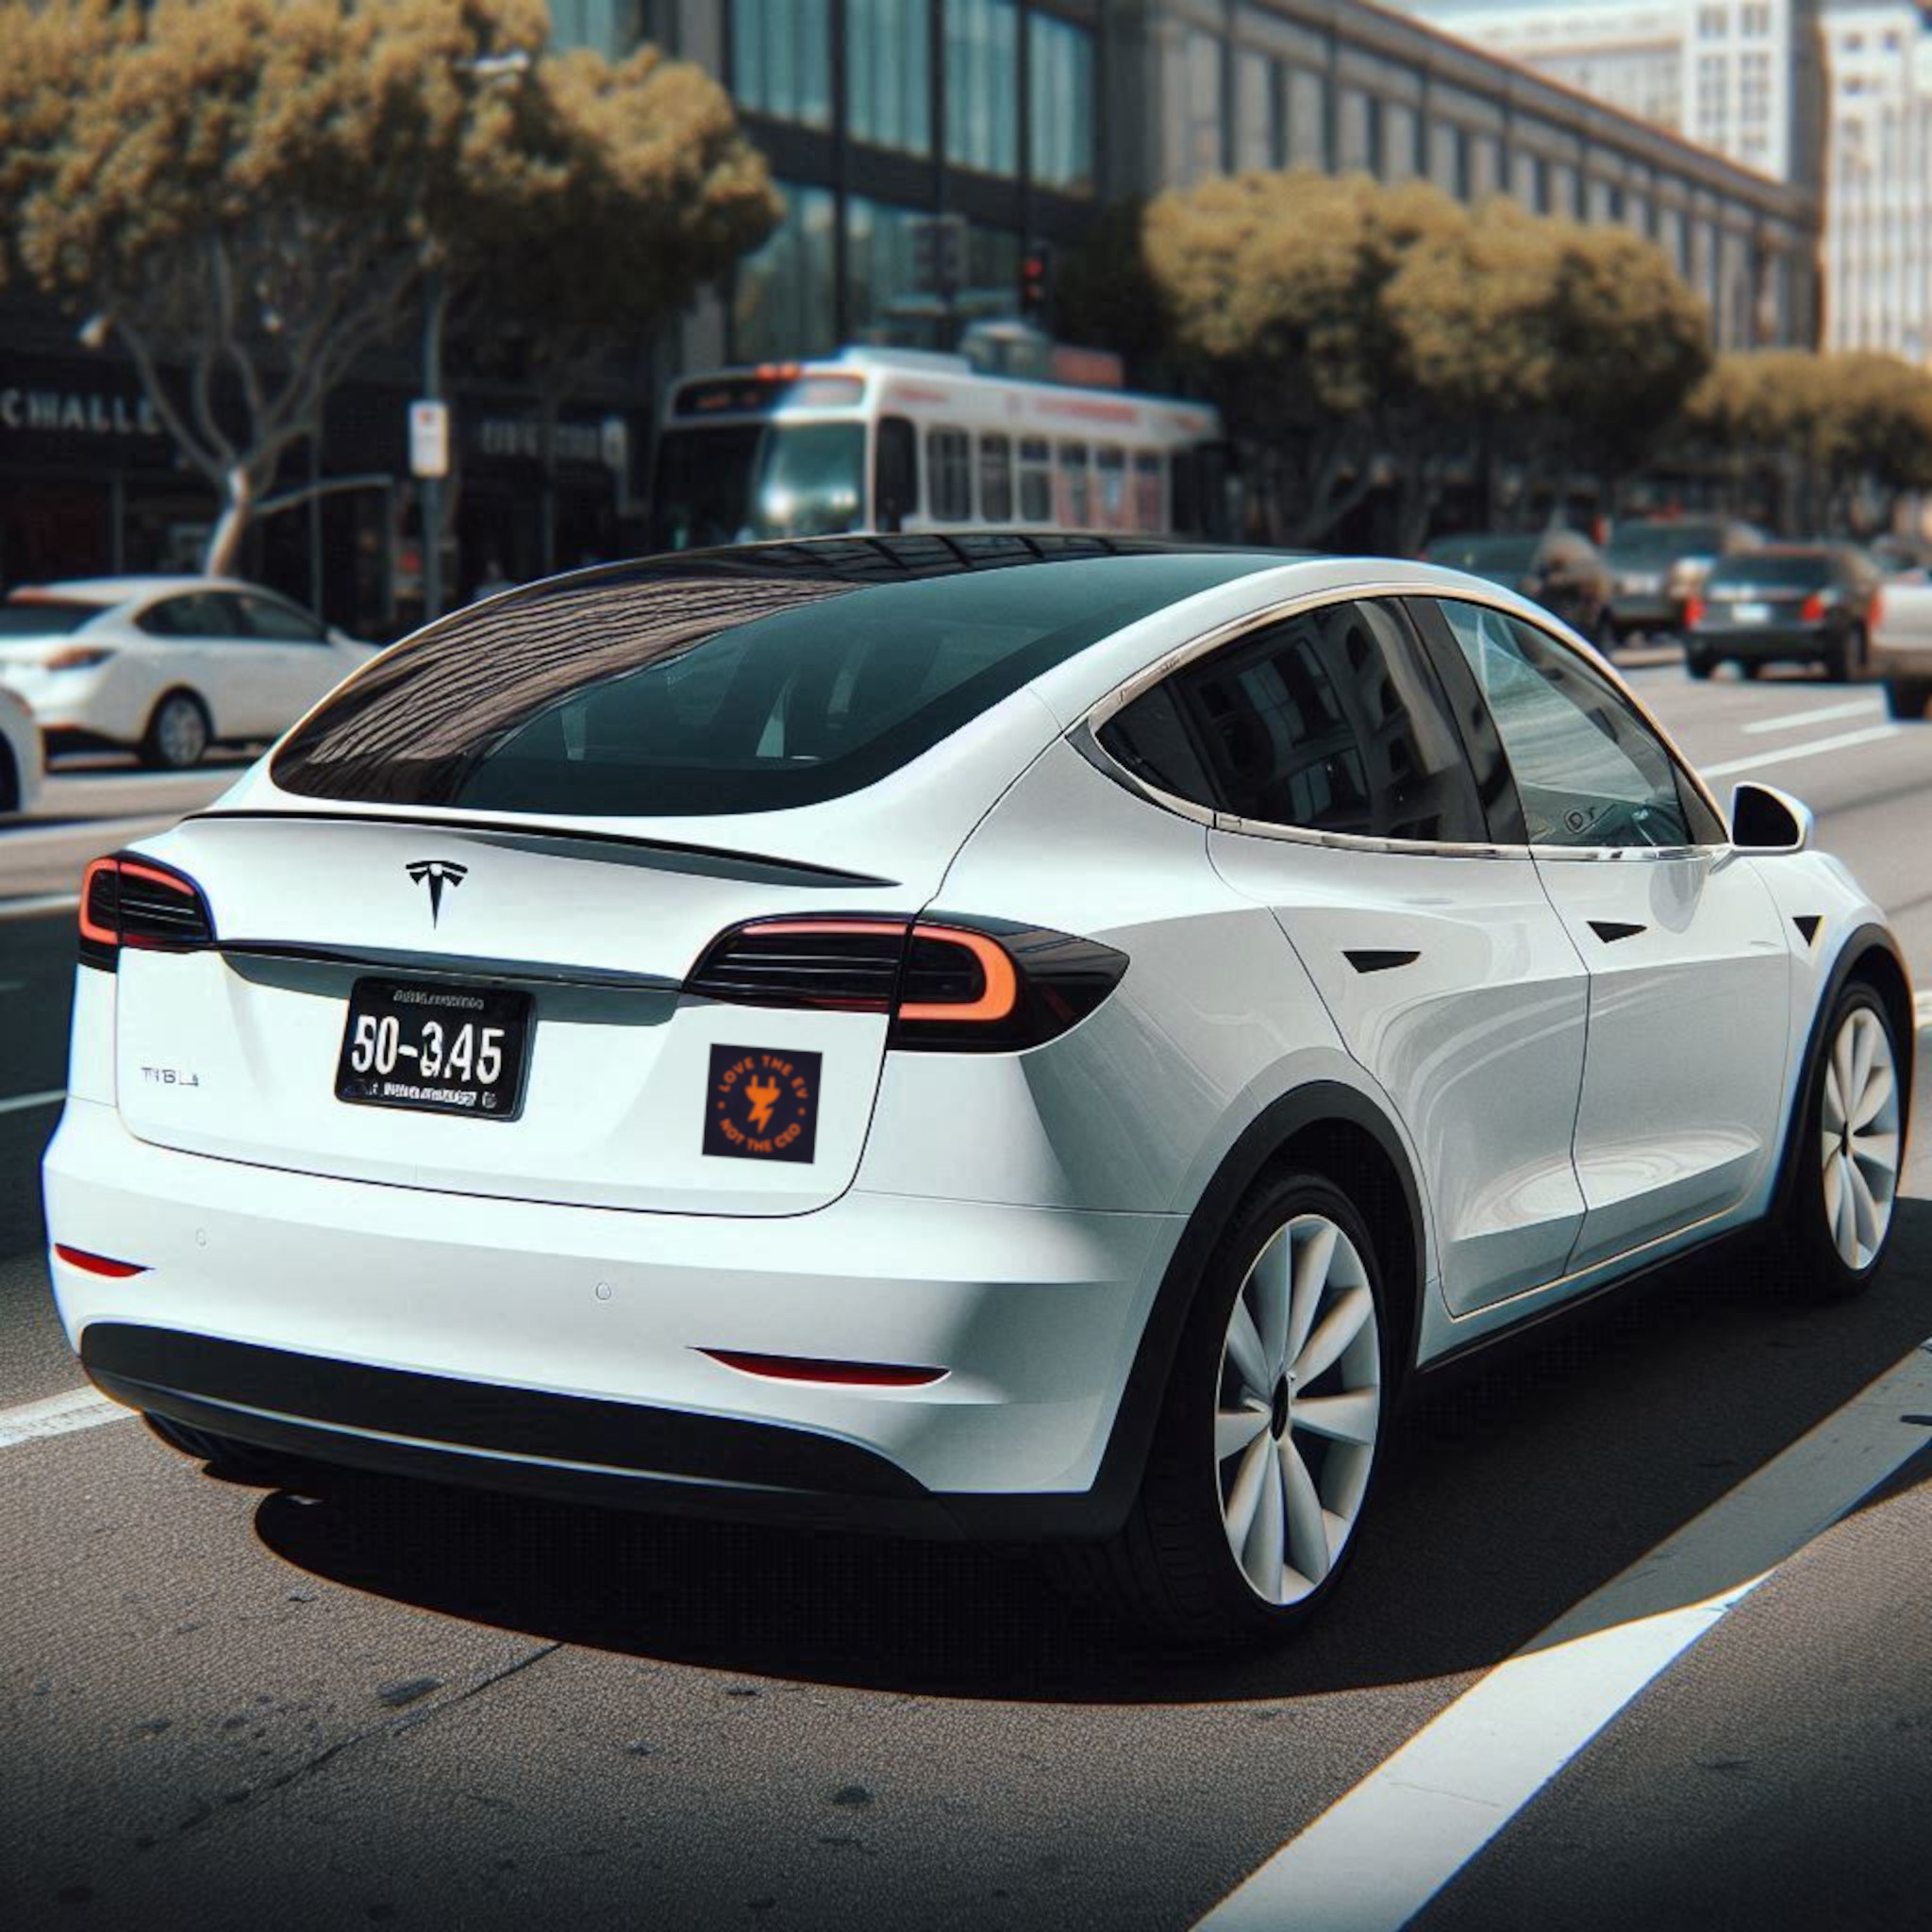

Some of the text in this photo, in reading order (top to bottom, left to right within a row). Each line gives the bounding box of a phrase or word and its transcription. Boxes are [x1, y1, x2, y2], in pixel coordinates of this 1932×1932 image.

[718, 1055, 808, 1099] LOVE THE EV
[720, 1118, 802, 1153] NOT THE CEO
